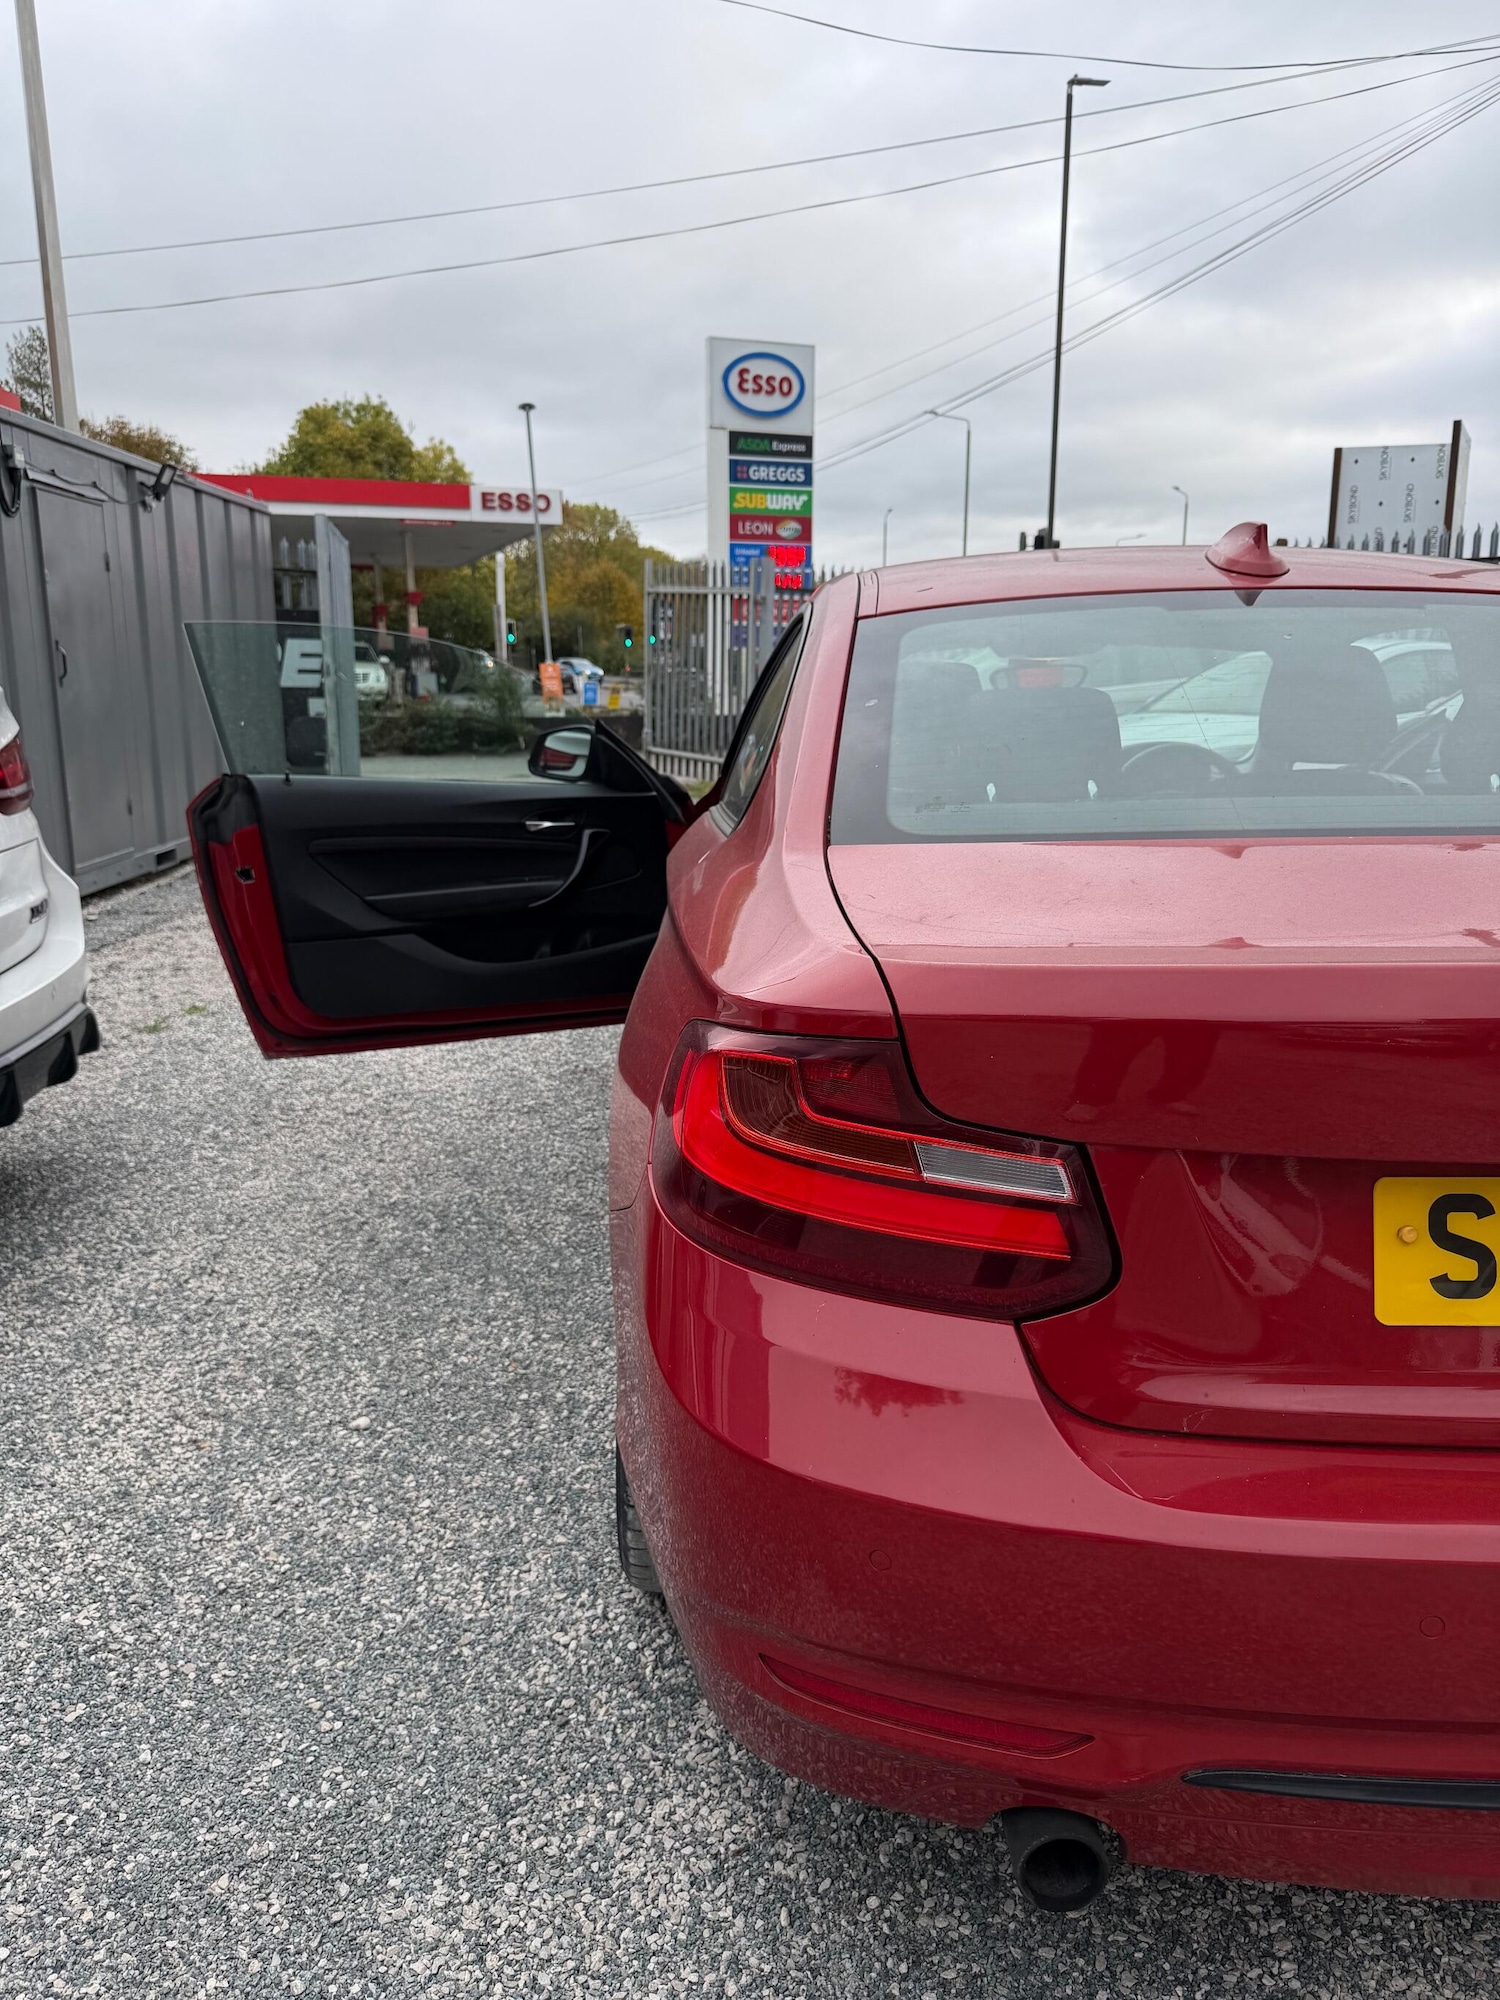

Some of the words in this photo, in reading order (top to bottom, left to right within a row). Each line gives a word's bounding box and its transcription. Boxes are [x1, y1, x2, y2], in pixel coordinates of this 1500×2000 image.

[738, 367, 793, 398] Esso
[772, 441, 807, 453] Express
[748, 466, 806, 482] GREGGS
[481, 491, 551, 513] ESSO
[733, 492, 809, 510] SUBWAY
[1347, 485, 1358, 525] SKYBOND
[1403, 483, 1415, 523] SKYBOND
[738, 521, 774, 535] LEON
[1428, 1193, 1497, 1300] S
